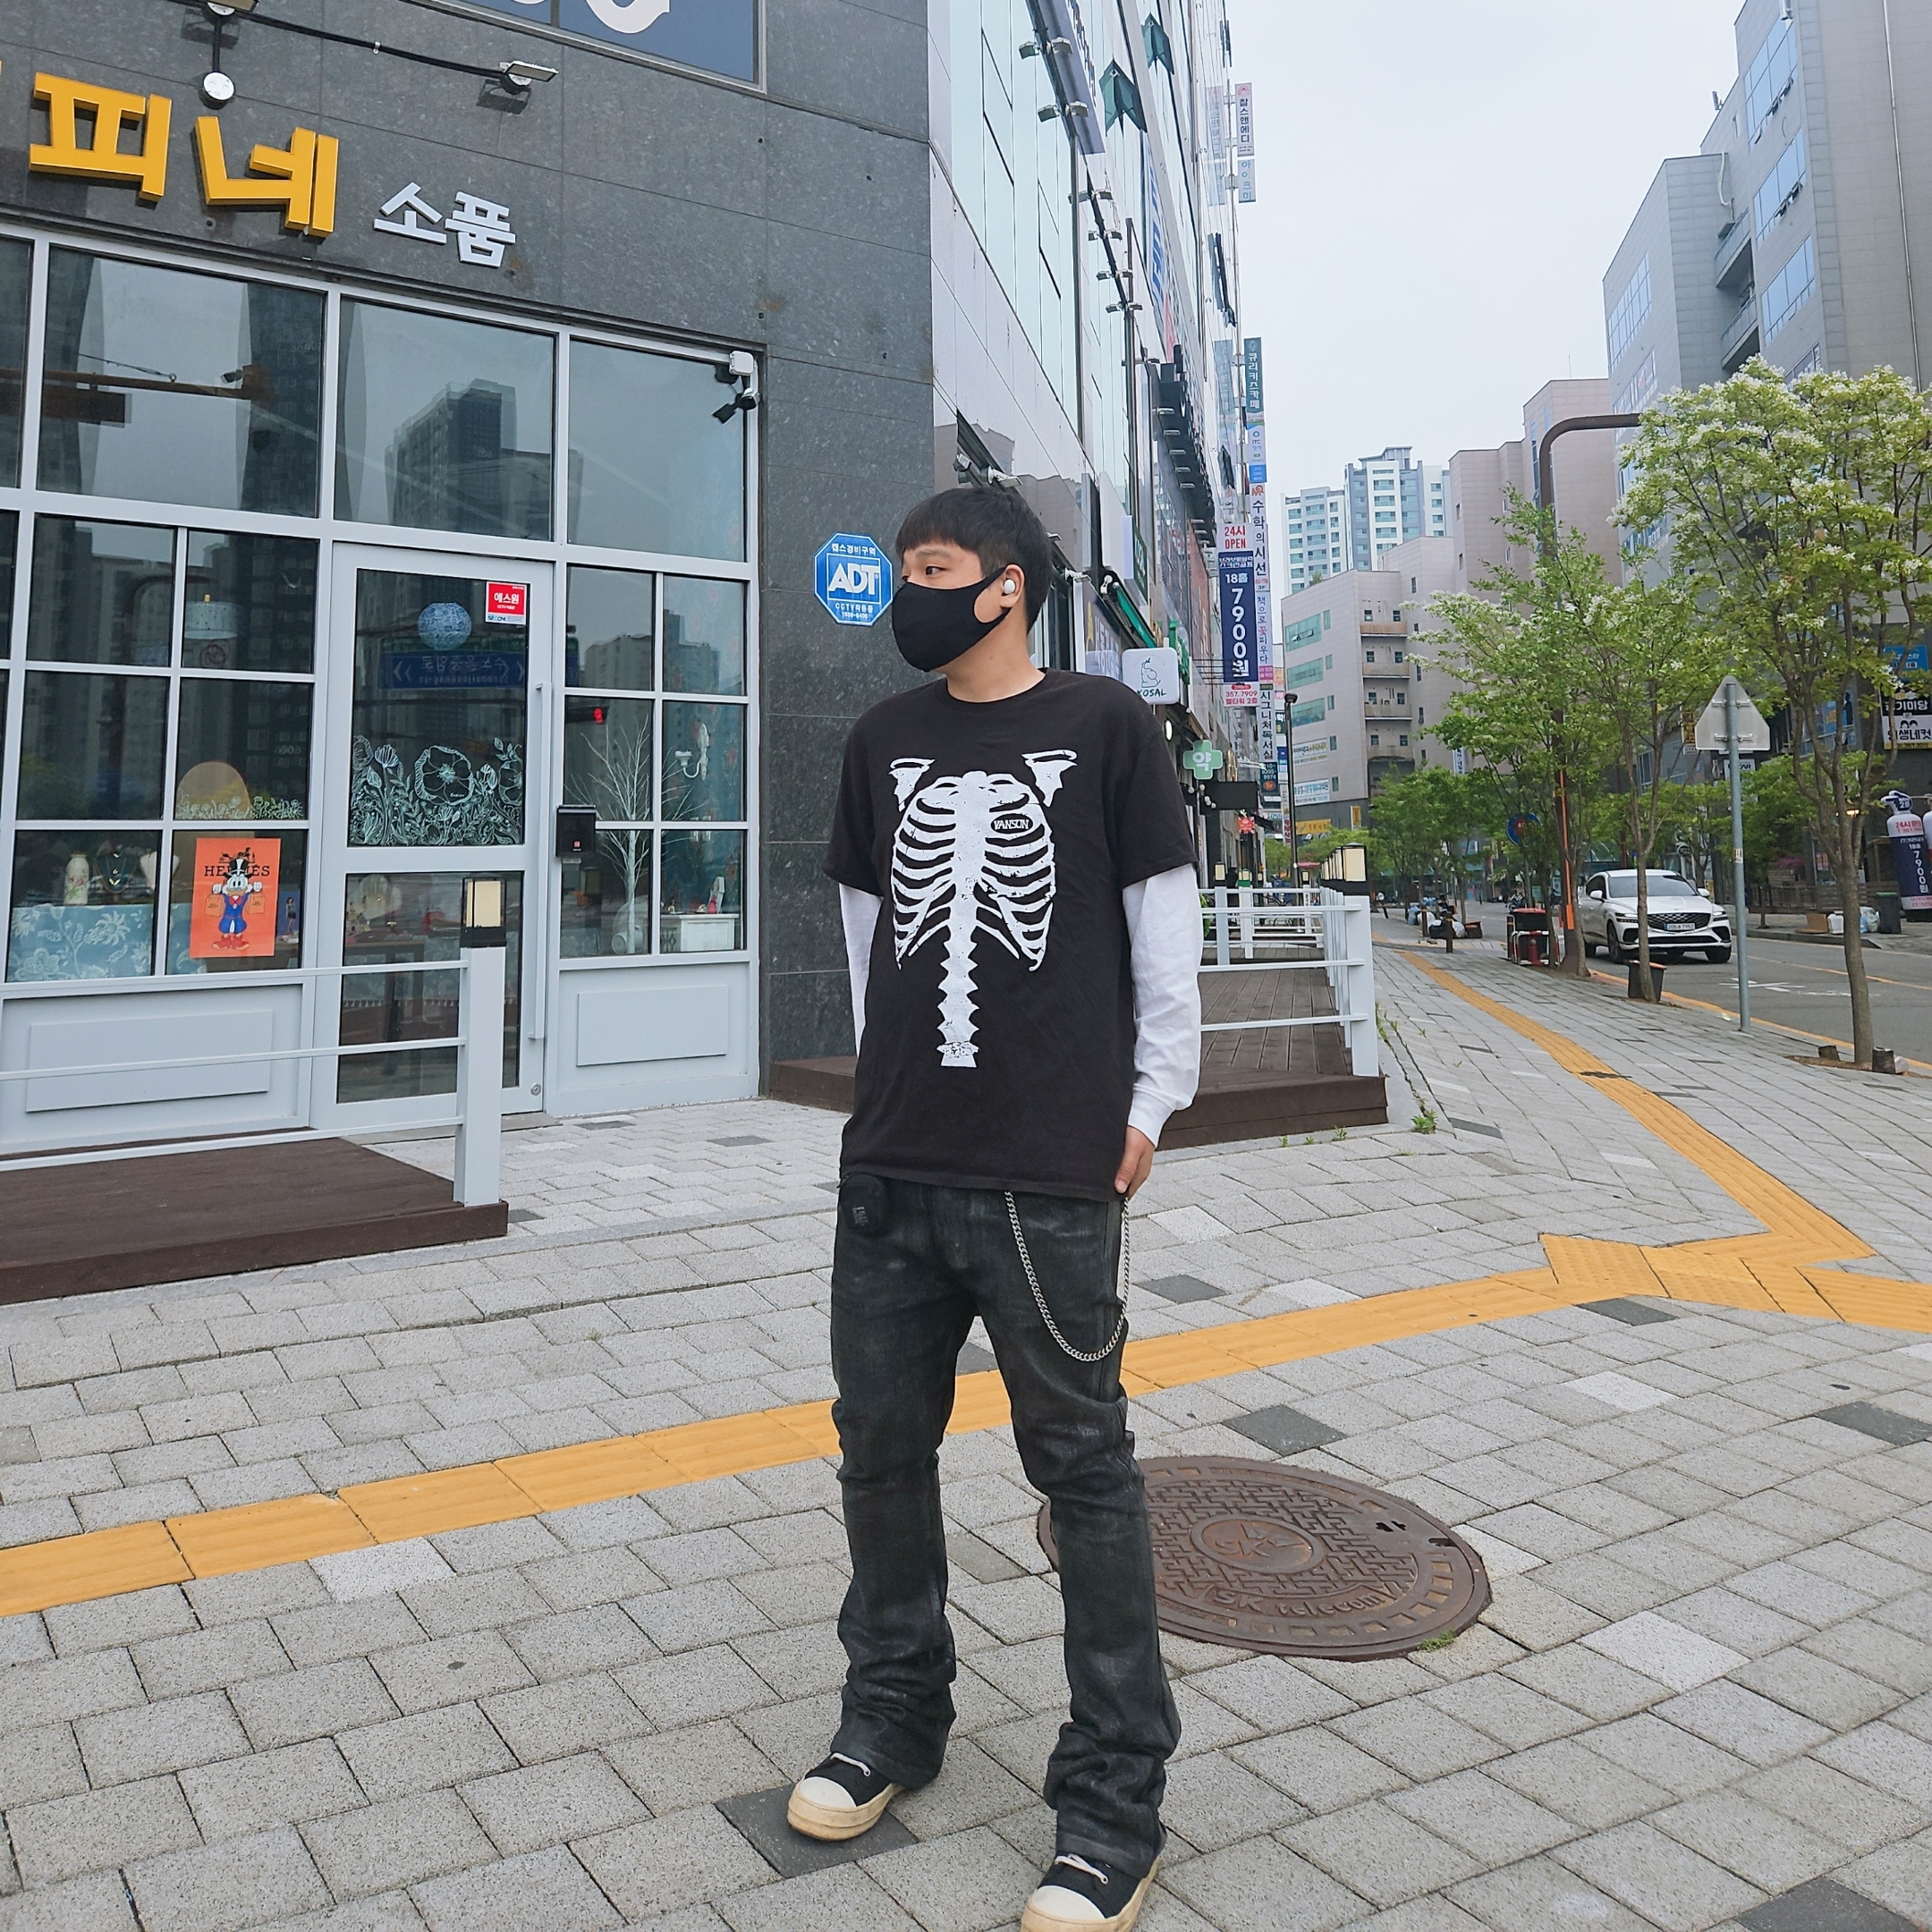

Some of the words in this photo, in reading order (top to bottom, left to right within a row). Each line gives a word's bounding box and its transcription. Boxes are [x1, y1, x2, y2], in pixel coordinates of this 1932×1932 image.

[0, 61, 338, 238] 피네
[373, 182, 516, 267] 소품
[1224, 525, 1246, 537] 24시
[831, 543, 876, 555] 캡스경비구역
[1224, 538, 1246, 549] OPEN
[827, 562, 880, 595] ADT
[1224, 572, 1248, 584] 18홀
[494, 592, 520, 605] 에스원
[835, 602, 874, 613] CCTV작동중
[1232, 588, 1250, 677] 7900원
[1192, 751, 1212, 772] 약
[993, 818, 1030, 830] VANSON
[204, 864, 270, 877] HEÈS
[1215, 1539, 1271, 1557] SK
[1214, 1588, 1264, 1612] SK
[1276, 1591, 1385, 1616] telecom
